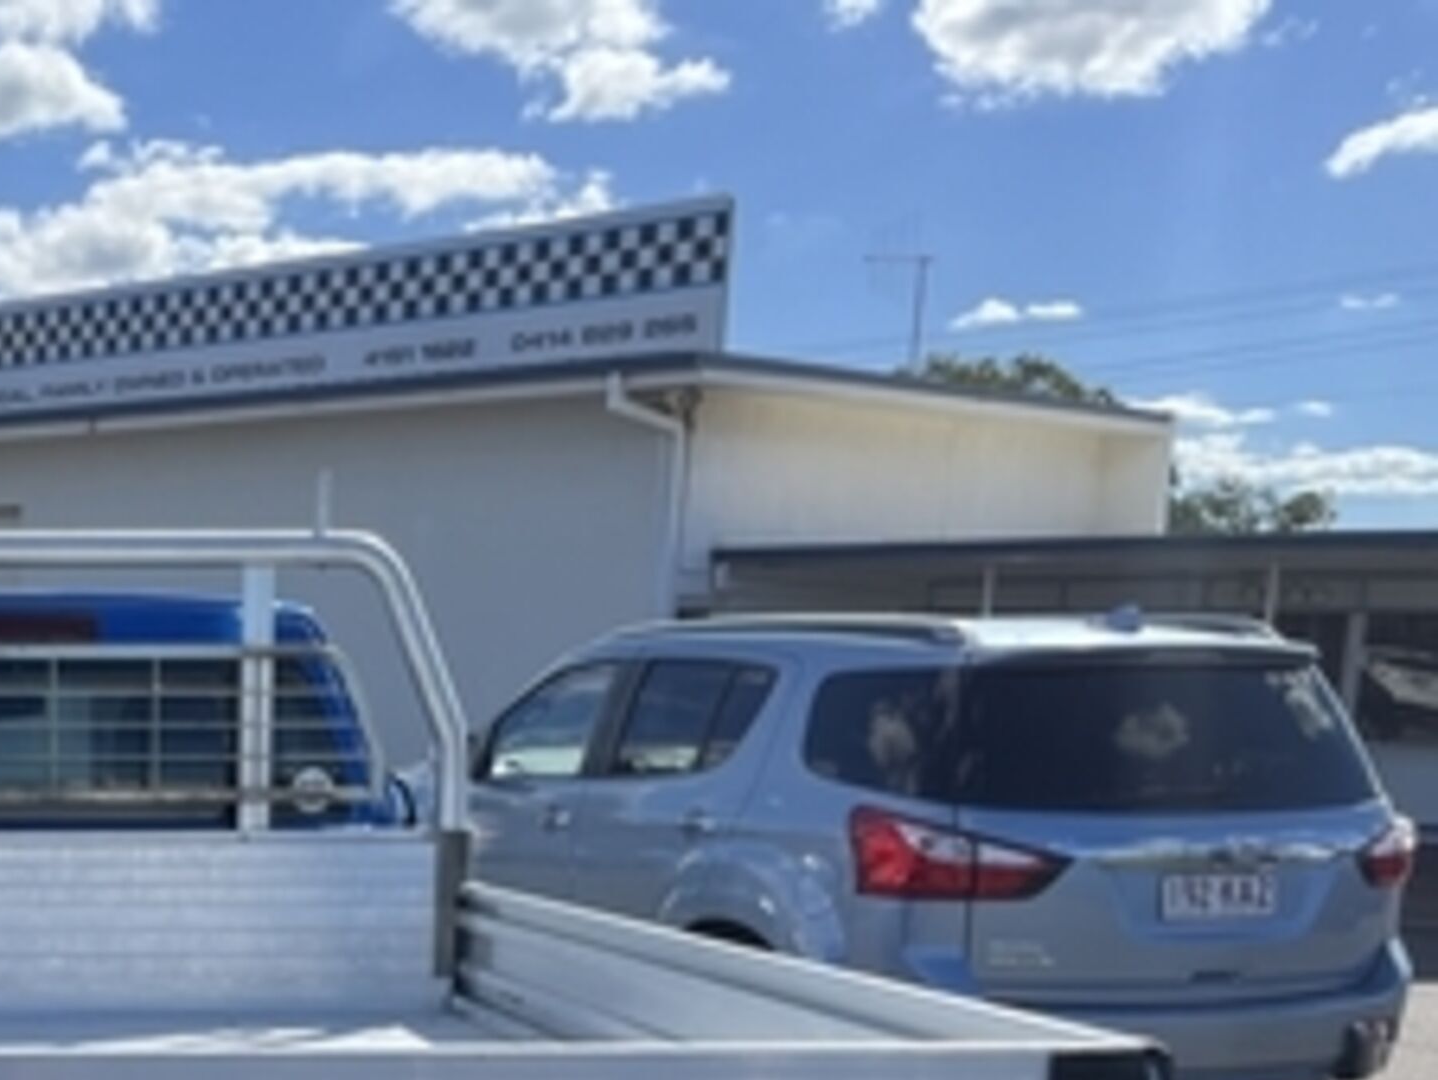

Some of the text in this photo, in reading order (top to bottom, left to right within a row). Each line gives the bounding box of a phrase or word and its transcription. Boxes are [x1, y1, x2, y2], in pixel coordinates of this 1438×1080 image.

[114, 370, 186, 394] OWNED
[191, 367, 205, 385] &
[210, 355, 328, 384] OPERATED
